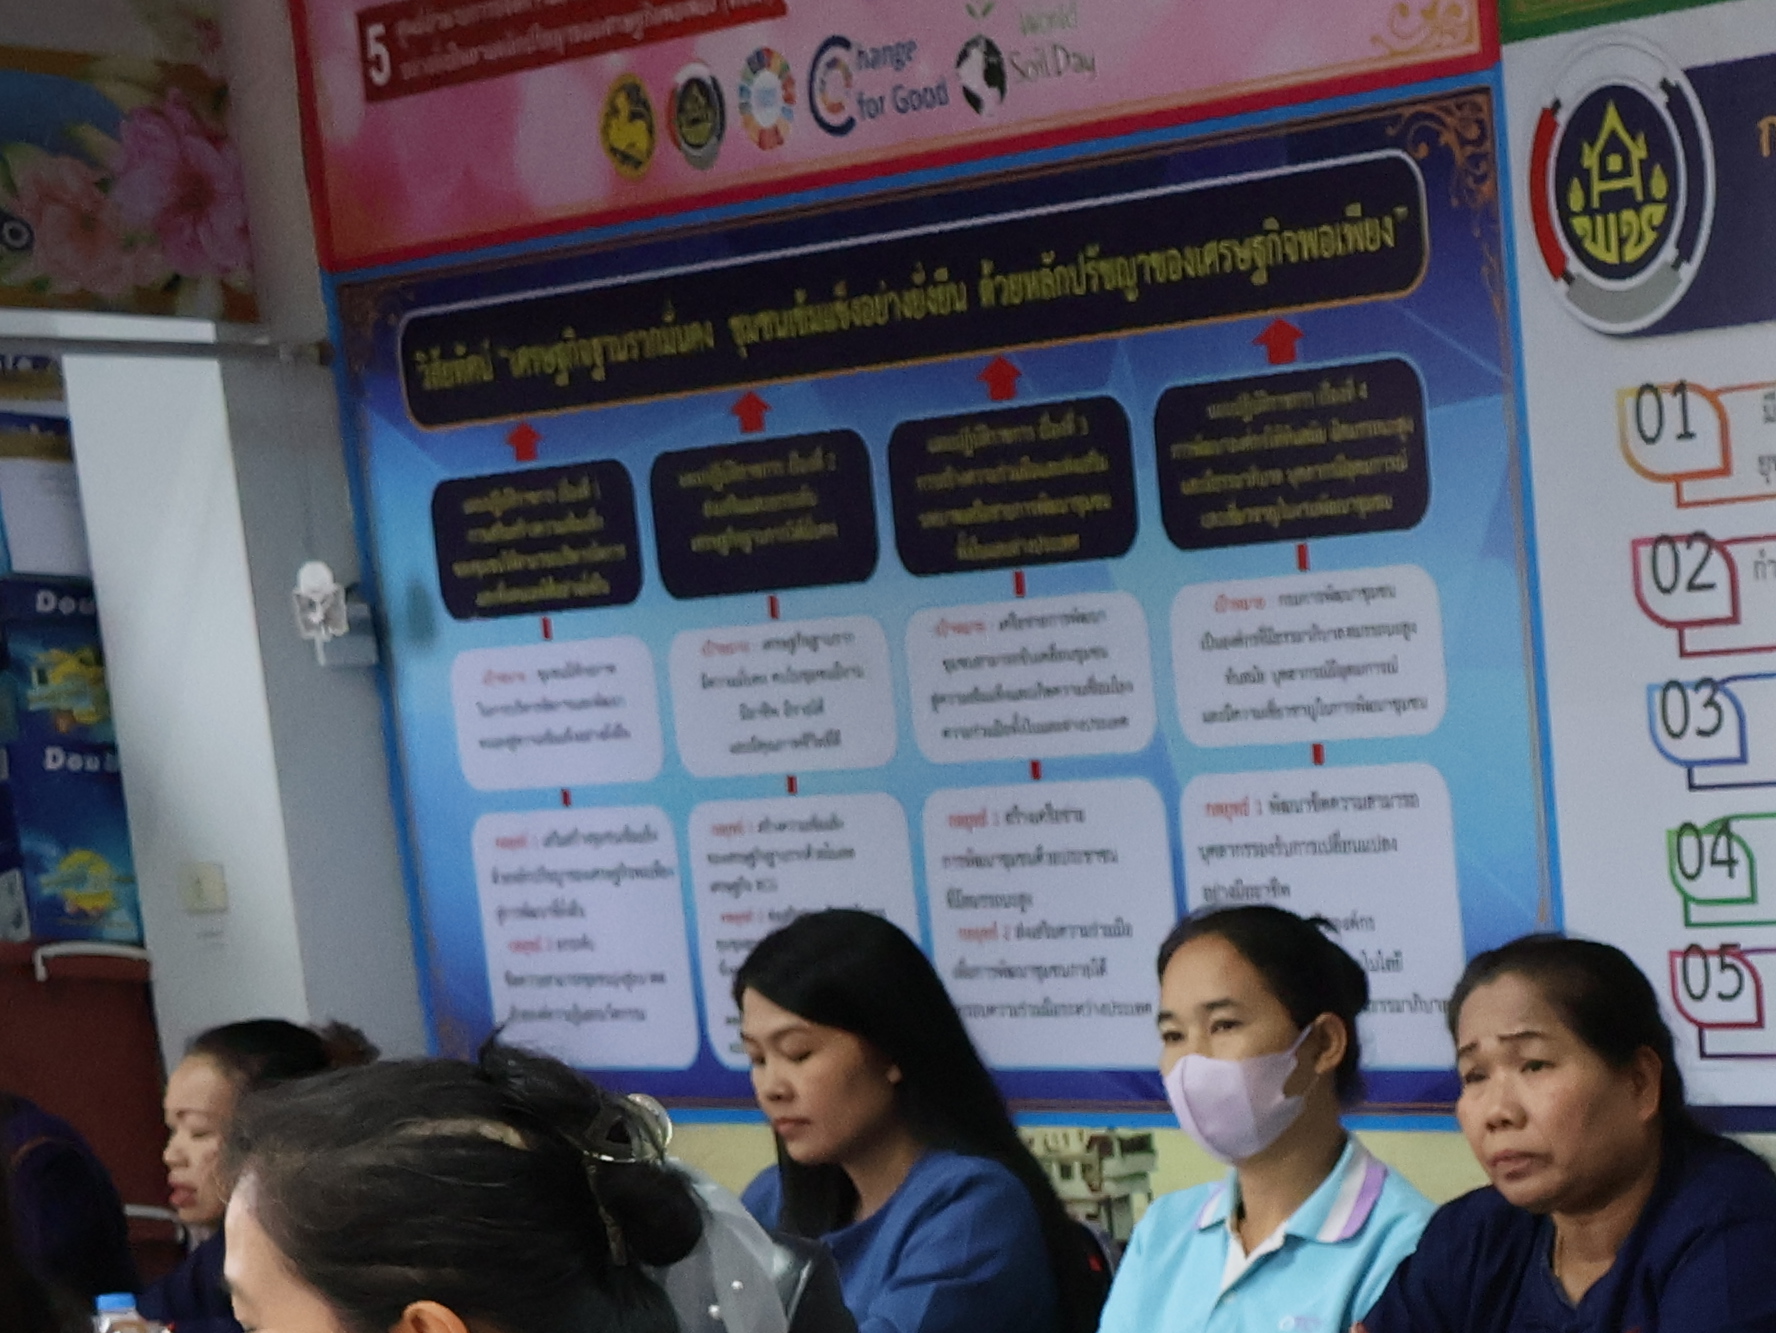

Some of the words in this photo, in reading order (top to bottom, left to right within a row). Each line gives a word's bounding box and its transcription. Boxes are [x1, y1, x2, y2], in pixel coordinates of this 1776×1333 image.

[366, 23, 393, 87] 5
[856, 90, 886, 119] for
[892, 76, 951, 115] Good
[1635, 381, 1697, 444] 01
[1651, 531, 1718, 595] 02
[1660, 678, 1724, 739] 03
[1676, 819, 1739, 879] 04
[1681, 944, 1745, 1002] 05
